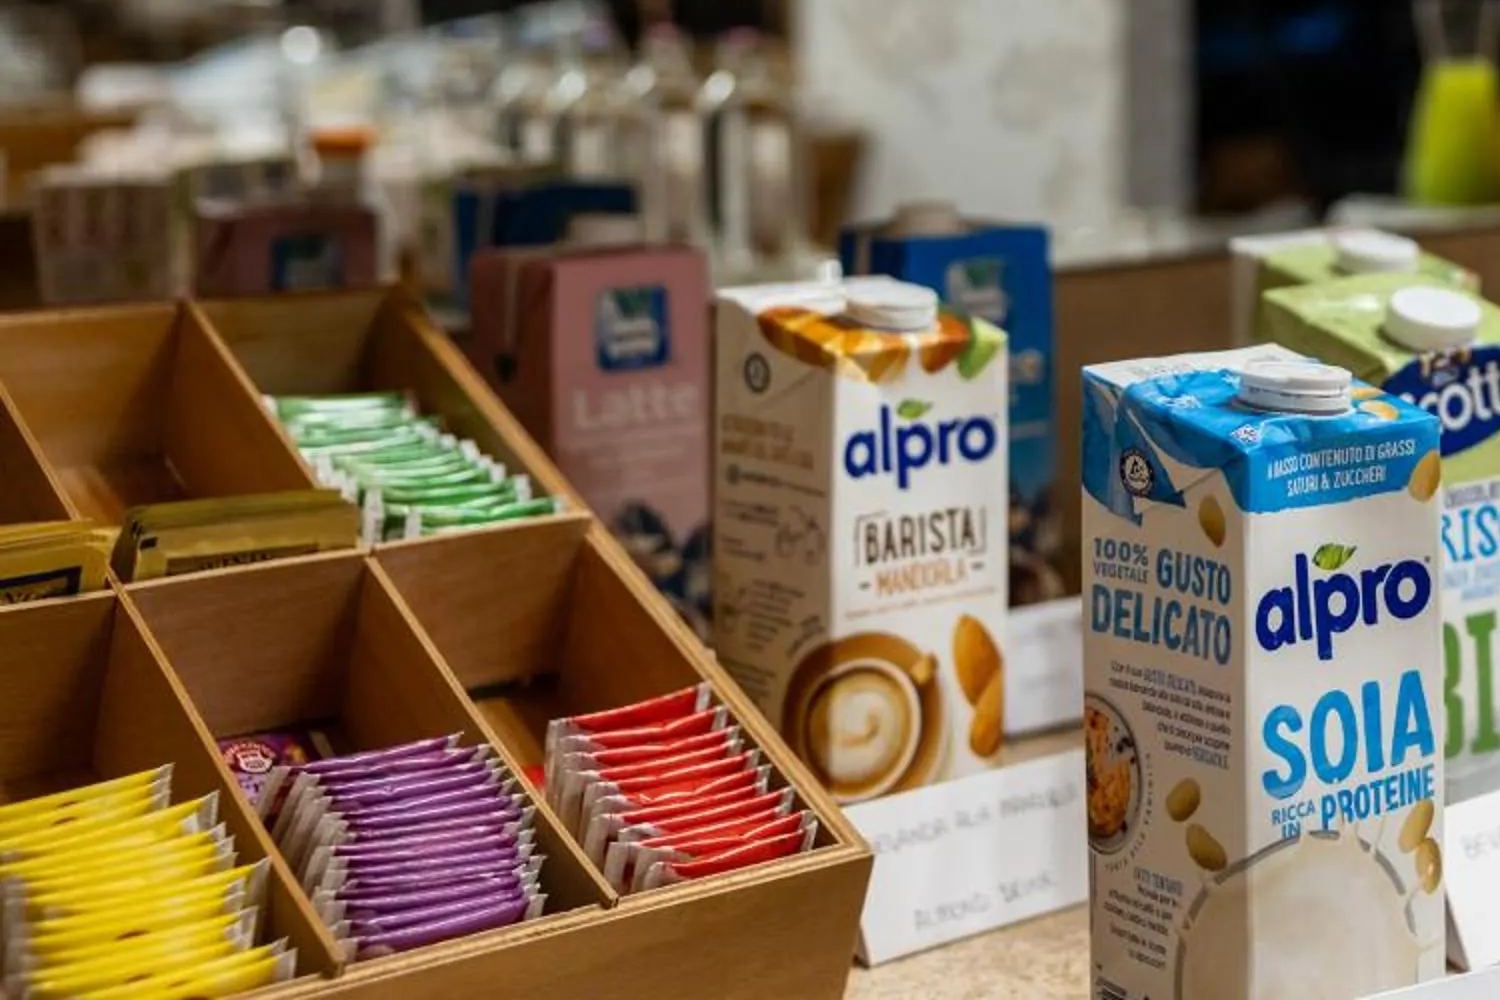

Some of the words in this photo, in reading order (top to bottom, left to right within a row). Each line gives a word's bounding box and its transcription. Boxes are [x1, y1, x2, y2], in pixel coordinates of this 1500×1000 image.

[844, 404, 996, 490] alpro
[1300, 445, 1362, 471] CONTENUTO
[1364, 444, 1375, 461] DI
[1377, 439, 1416, 461] GRASSI
[1333, 464, 1387, 489] ZUCCHERI
[865, 507, 976, 565] BARISTA
[1094, 537, 1149, 567] 100%
[877, 560, 968, 598] MANDORLA
[1094, 561, 1149, 584] VEGETALE
[1156, 548, 1231, 606] GUSTO
[1091, 583, 1231, 666] DELICATO
[1256, 553, 1431, 661] alpro
[1261, 669, 1435, 800] SOIA
[1271, 802, 1316, 826] RICCA
[1321, 763, 1435, 831] PROTEINE
[1281, 821, 1302, 842] IN
